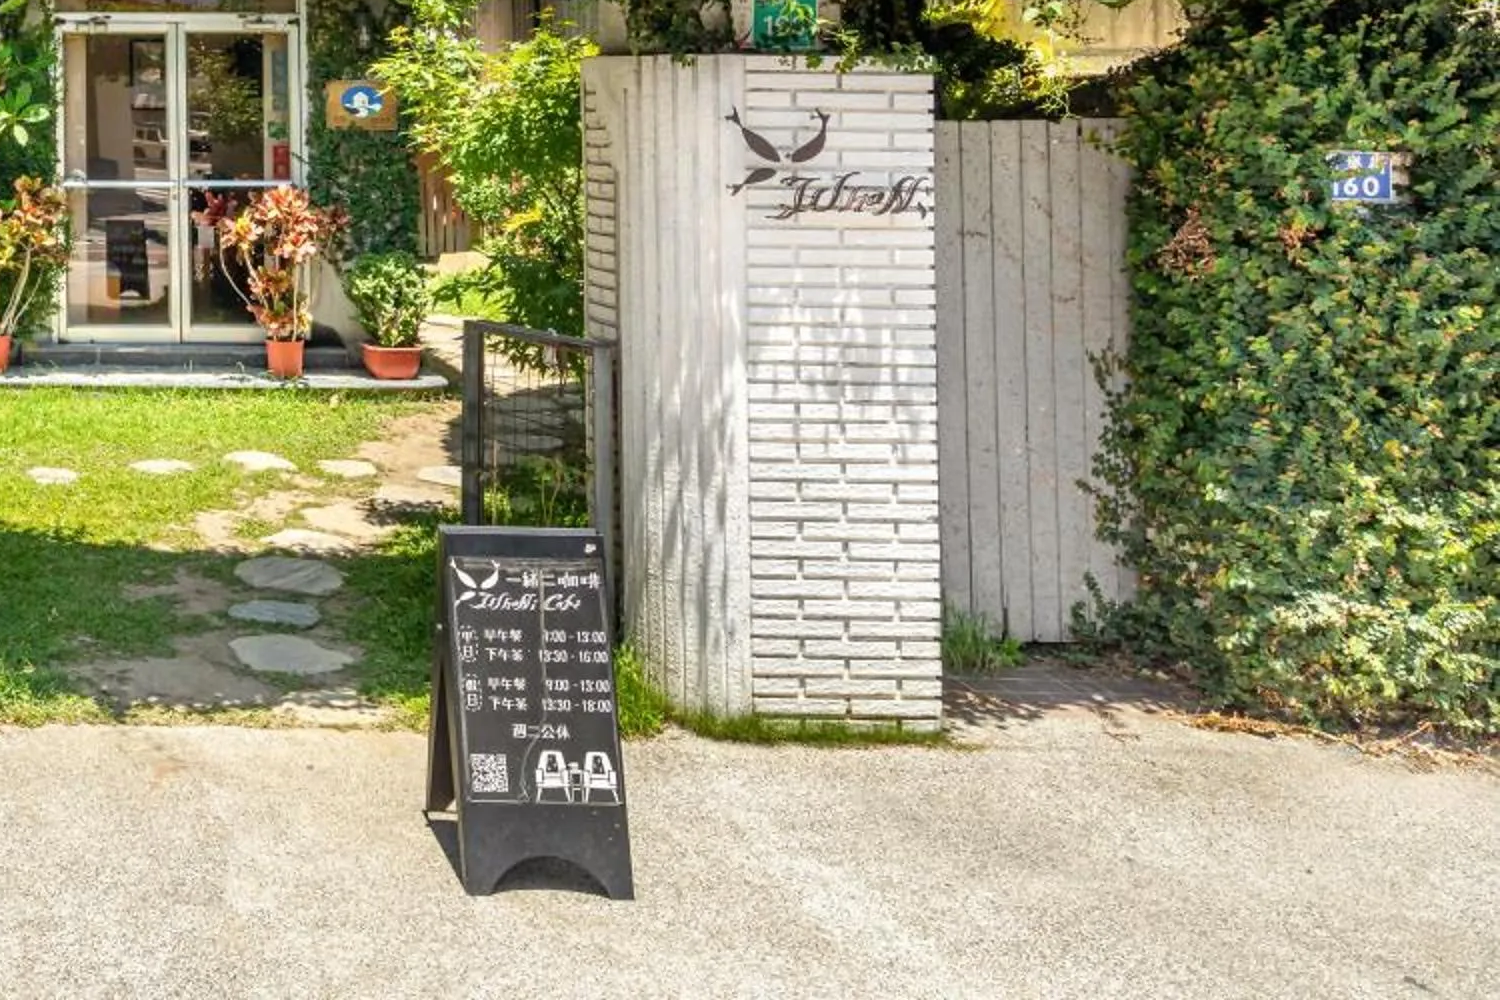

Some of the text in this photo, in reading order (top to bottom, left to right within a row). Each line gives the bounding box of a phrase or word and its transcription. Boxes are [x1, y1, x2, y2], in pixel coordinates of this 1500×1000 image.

[1332, 176, 1380, 197] 160
[485, 628, 522, 643] 早午餐
[485, 648, 524, 662] 下午茶
[488, 677, 526, 691] 早午餐
[489, 696, 528, 711] 下午茶
[512, 723, 570, 740] 週二公休
